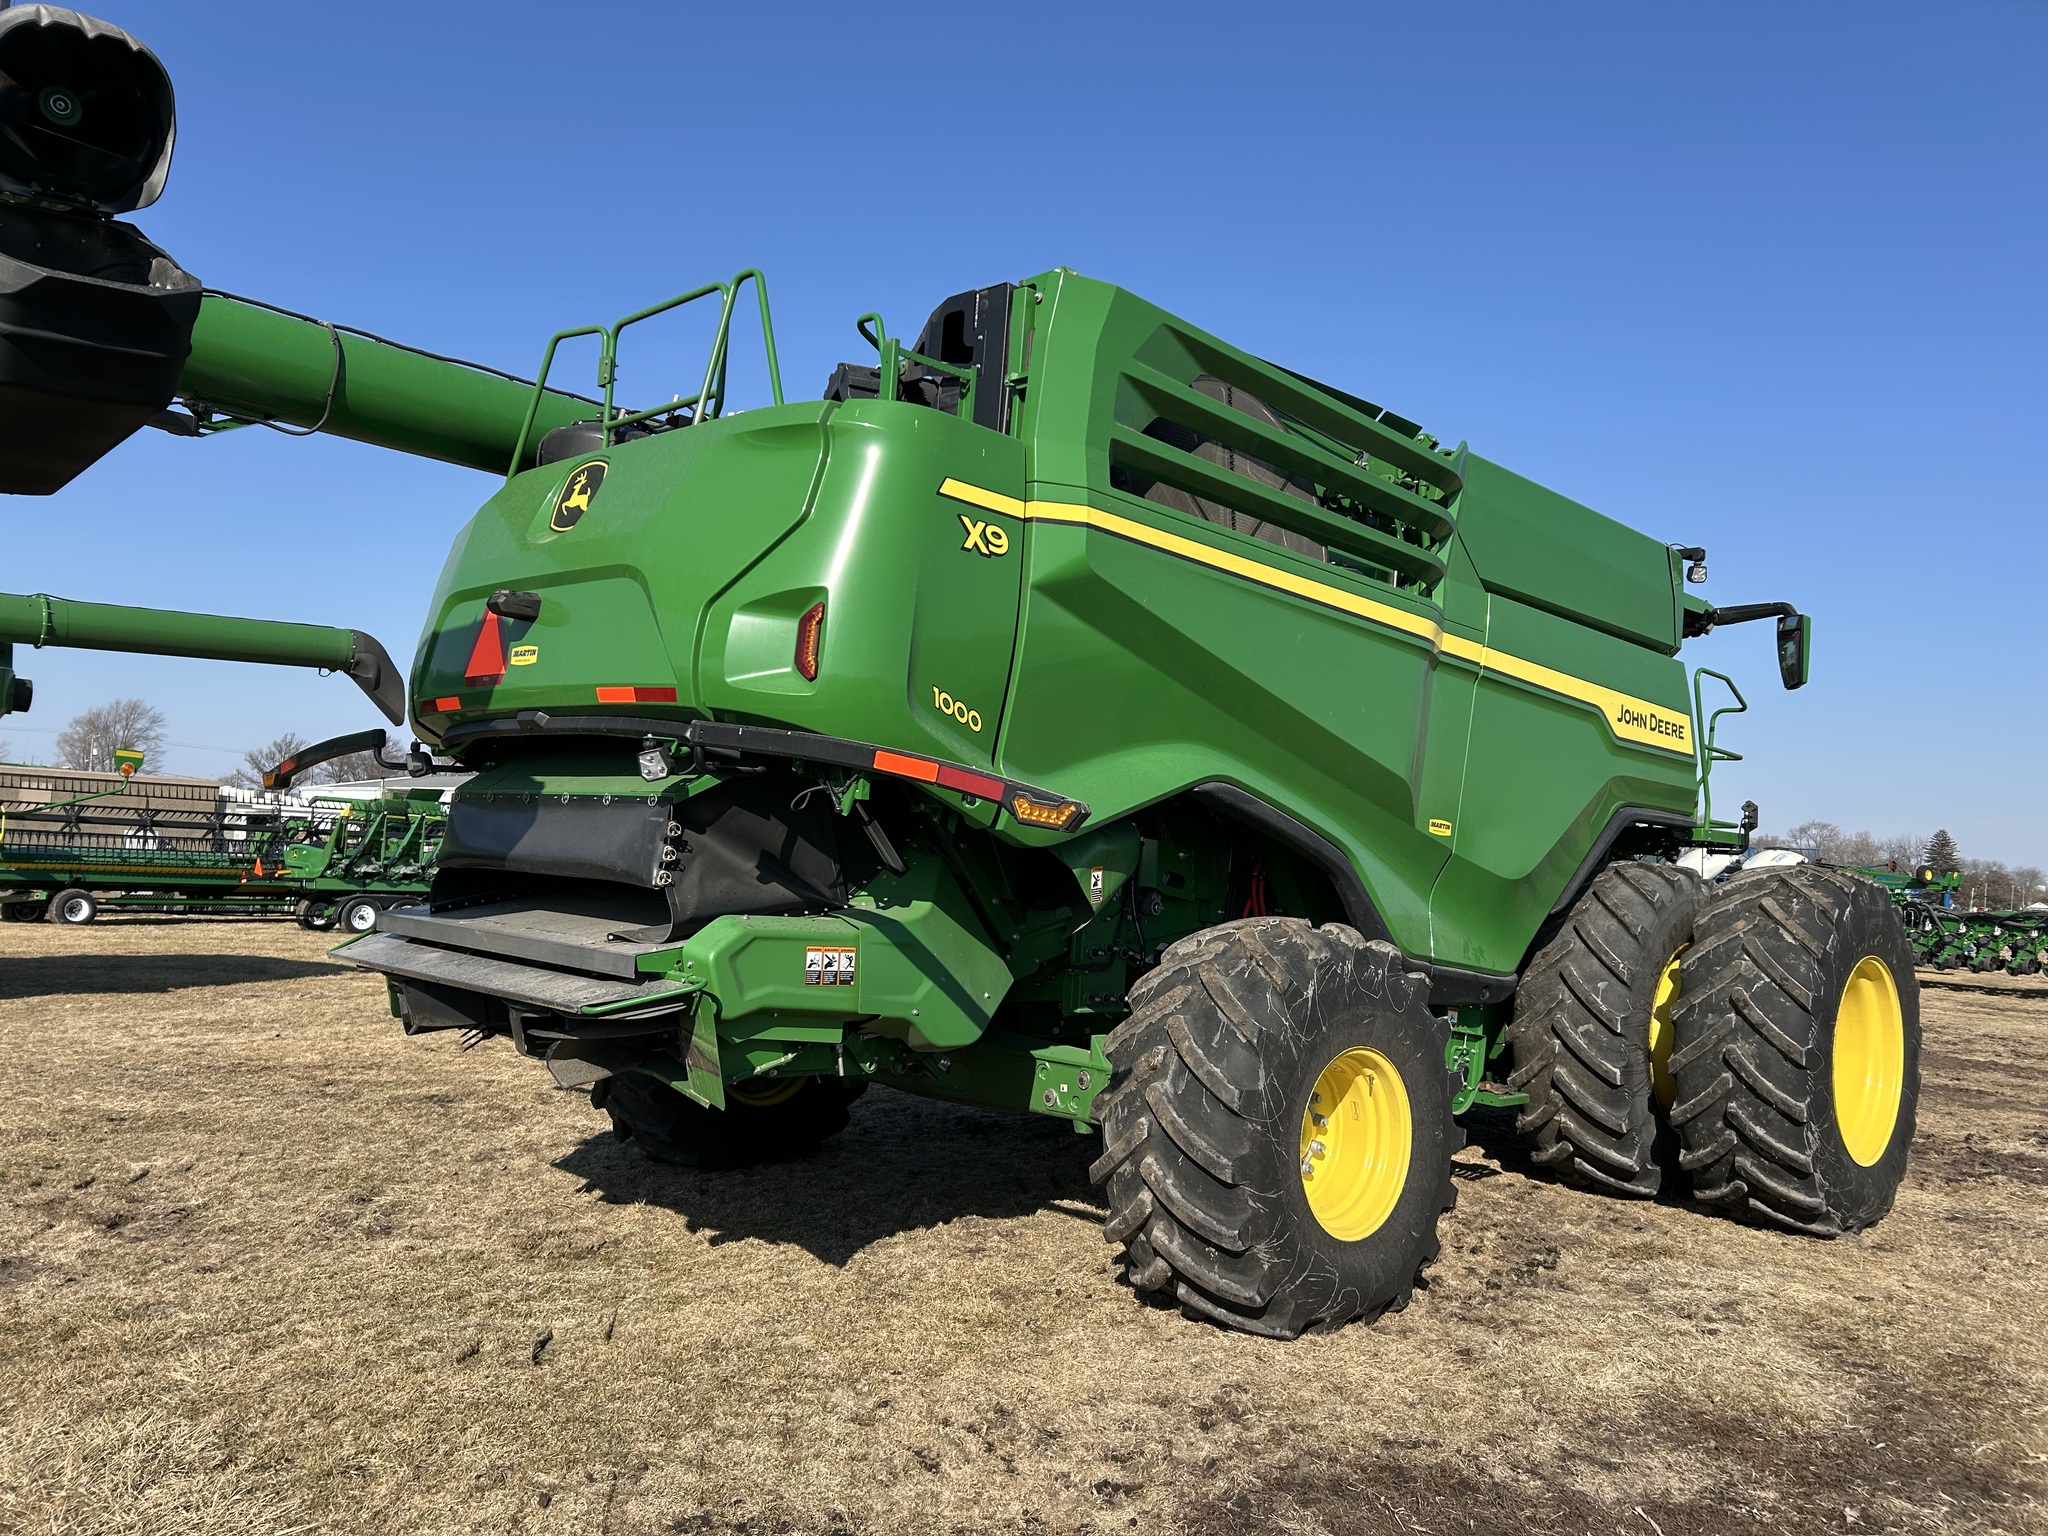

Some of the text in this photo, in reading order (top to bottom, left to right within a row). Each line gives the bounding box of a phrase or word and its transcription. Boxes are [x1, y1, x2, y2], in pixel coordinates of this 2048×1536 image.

[958, 514, 1010, 558] X9
[513, 649, 537, 657] MARTIN
[932, 685, 982, 733] 1000
[1617, 704, 1685, 740] JOHN DEERE
